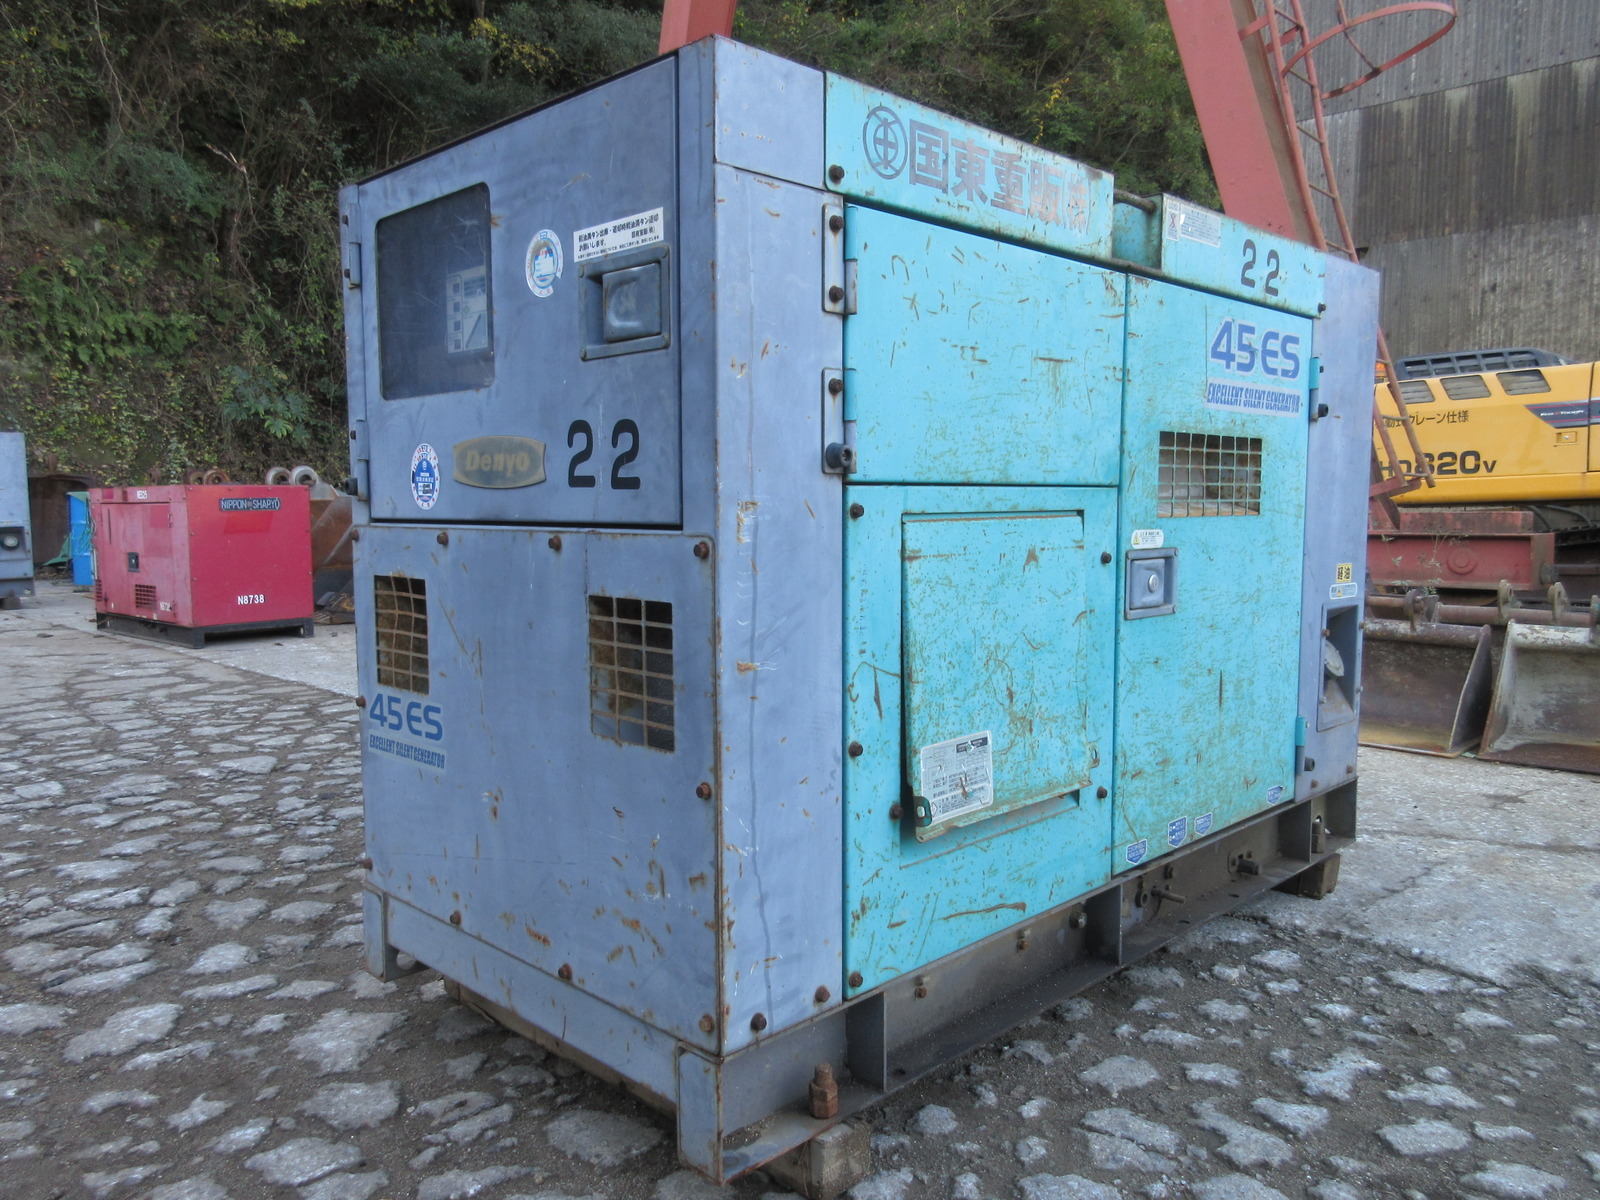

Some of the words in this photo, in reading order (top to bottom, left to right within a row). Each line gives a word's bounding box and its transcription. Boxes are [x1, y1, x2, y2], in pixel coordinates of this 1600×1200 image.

[1241, 239, 1280, 297] 22
[1210, 320, 1301, 379] 45ES
[1206, 382, 1244, 407] EXCELLENT
[1243, 387, 1266, 410] SILENT
[1264, 390, 1301, 413] GENERATOR
[465, 451, 531, 477] Denyo
[567, 418, 642, 490] 22
[221, 499, 247, 509] NIPPON
[252, 499, 280, 510] SHARYO
[237, 594, 265, 605] N8738
[369, 693, 443, 741] 45ES
[369, 733, 395, 755] EXCELLENT
[395, 741, 414, 760] SILENT
[413, 745, 446, 769] GENERATOR
